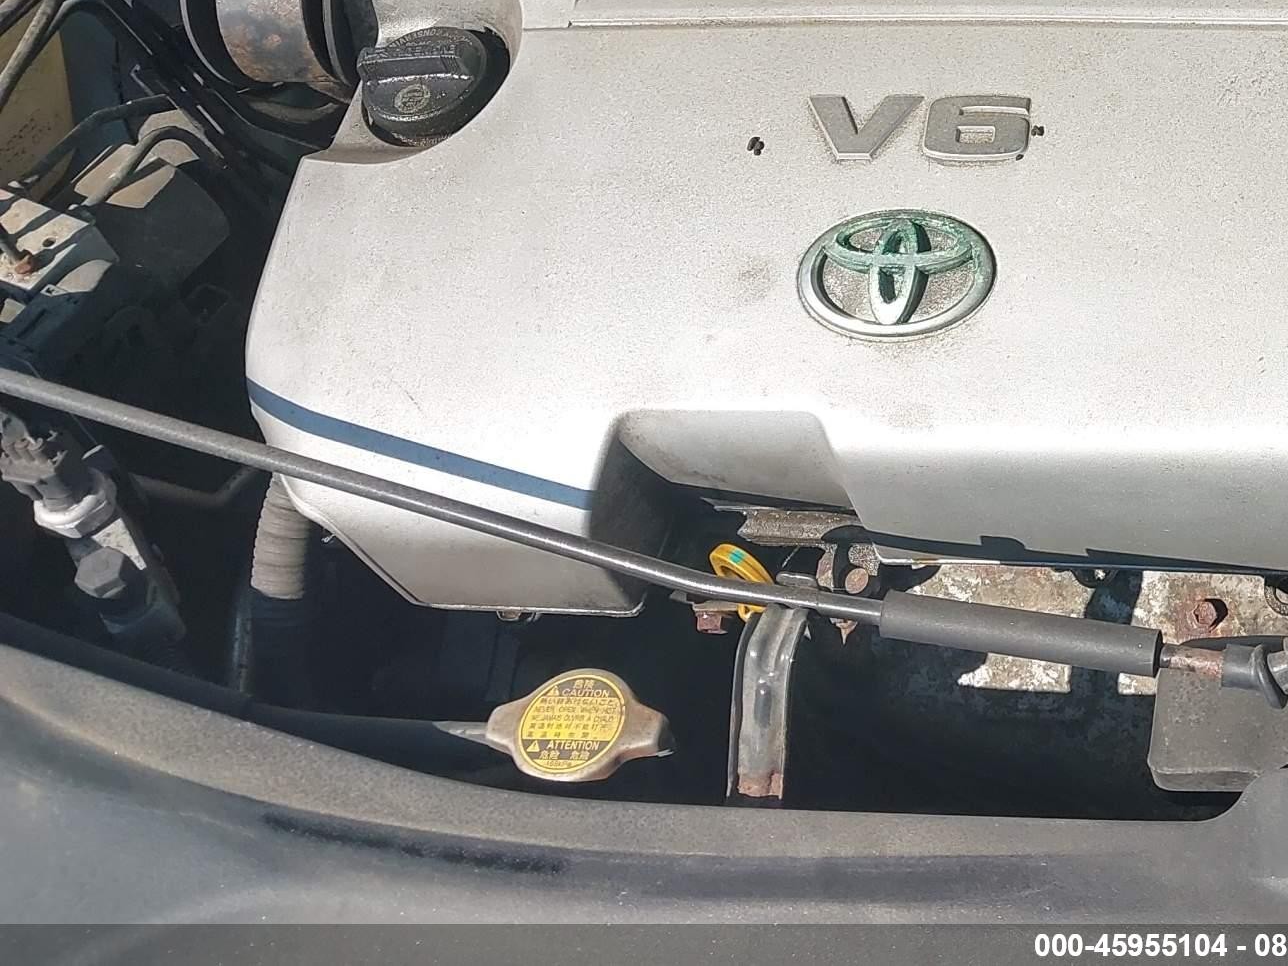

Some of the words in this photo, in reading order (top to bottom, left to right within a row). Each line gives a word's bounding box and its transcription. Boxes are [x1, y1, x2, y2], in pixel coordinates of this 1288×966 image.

[808, 94, 1031, 161] V6
[561, 688, 610, 698] CAUTION
[546, 740, 600, 751] ATTENTION
